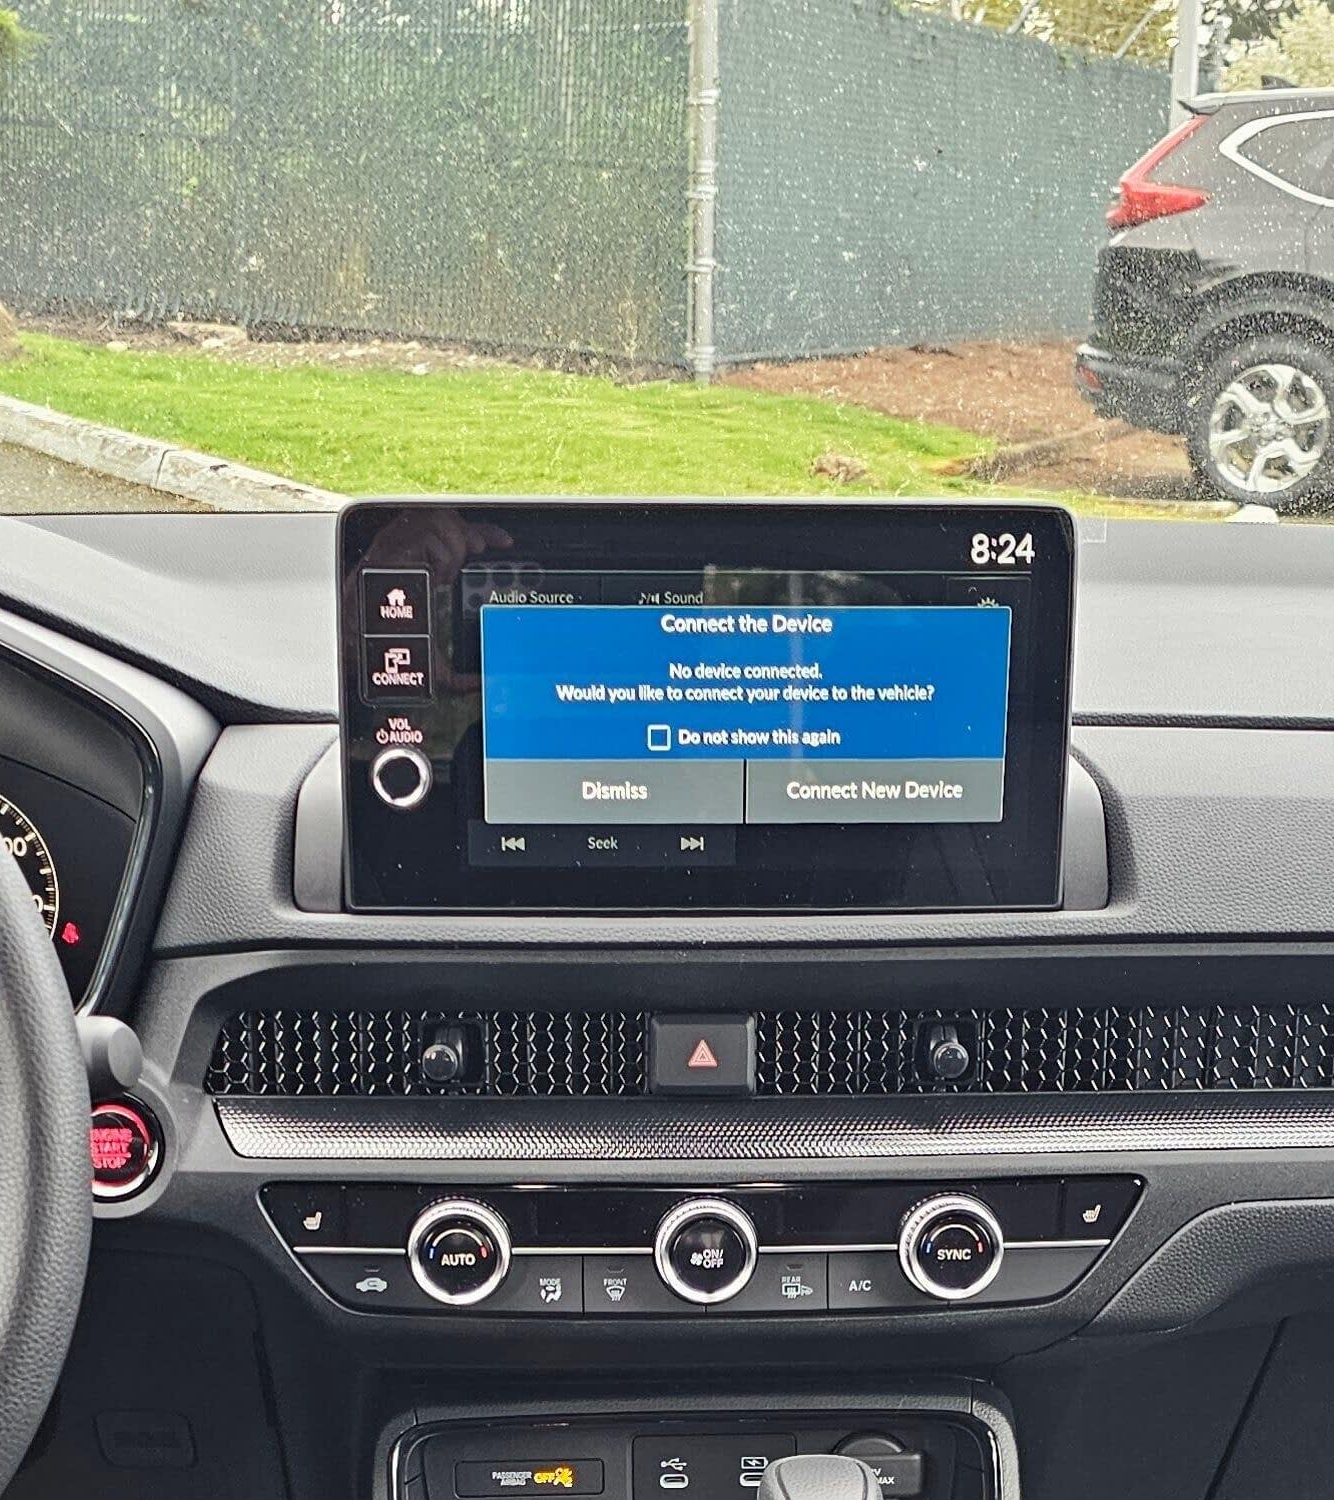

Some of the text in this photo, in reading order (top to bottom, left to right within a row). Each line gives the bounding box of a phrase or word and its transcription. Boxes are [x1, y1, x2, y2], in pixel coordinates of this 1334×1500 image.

[971, 533, 1035, 565] 8:24
[489, 591, 574, 603] Audio Source
[664, 591, 703, 604] Sound
[380, 606, 413, 619] HOME
[661, 614, 833, 633] Connect the Device
[670, 662, 823, 679] No device connected.
[372, 672, 424, 685] CONNECT
[556, 684, 935, 704] Would you like to connect your device to the vehicle?
[388, 718, 411, 730] VOL
[389, 731, 423, 743] AUDIO
[678, 729, 841, 748] Do not show this again
[582, 781, 648, 800] Dismiss
[786, 780, 963, 800] Connect New Device
[587, 835, 618, 851] Seek
[93, 1157, 127, 1169] STOP
[441, 1253, 476, 1267] AUTO
[937, 1248, 972, 1261] SYNC
[703, 1258, 724, 1268] OFF
[604, 1278, 627, 1286] FRONT
[849, 1280, 872, 1291] A/C
